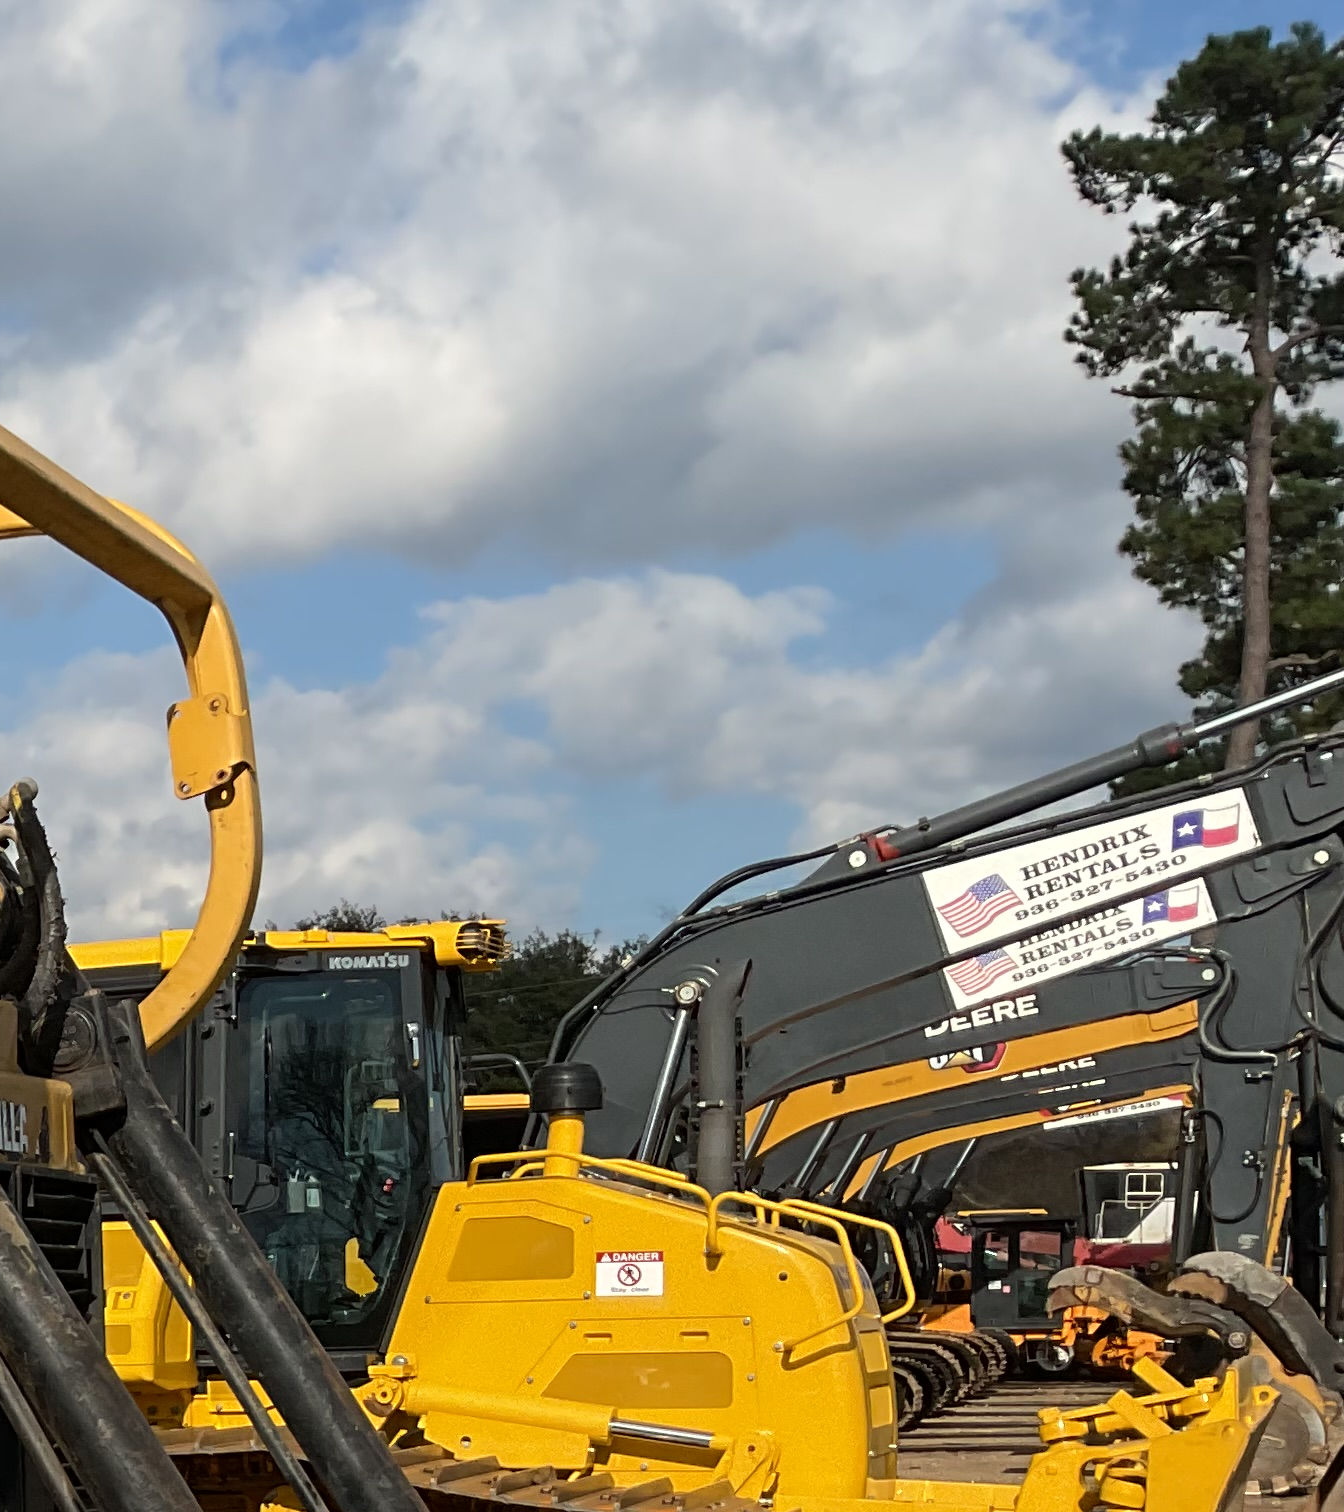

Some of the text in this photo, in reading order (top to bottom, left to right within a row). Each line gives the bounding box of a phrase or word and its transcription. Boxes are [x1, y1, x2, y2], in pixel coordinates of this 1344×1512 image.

[1019, 824, 1152, 881] HENDRIX
[1024, 843, 1160, 900] RENTALS
[1014, 855, 1187, 921] 936-327-5430
[328, 951, 410, 970] KOMATSU
[1011, 927, 1156, 982] 936-327-5430
[1019, 918, 1134, 966] RENTALS
[612, 1251, 660, 1262] DANGER
